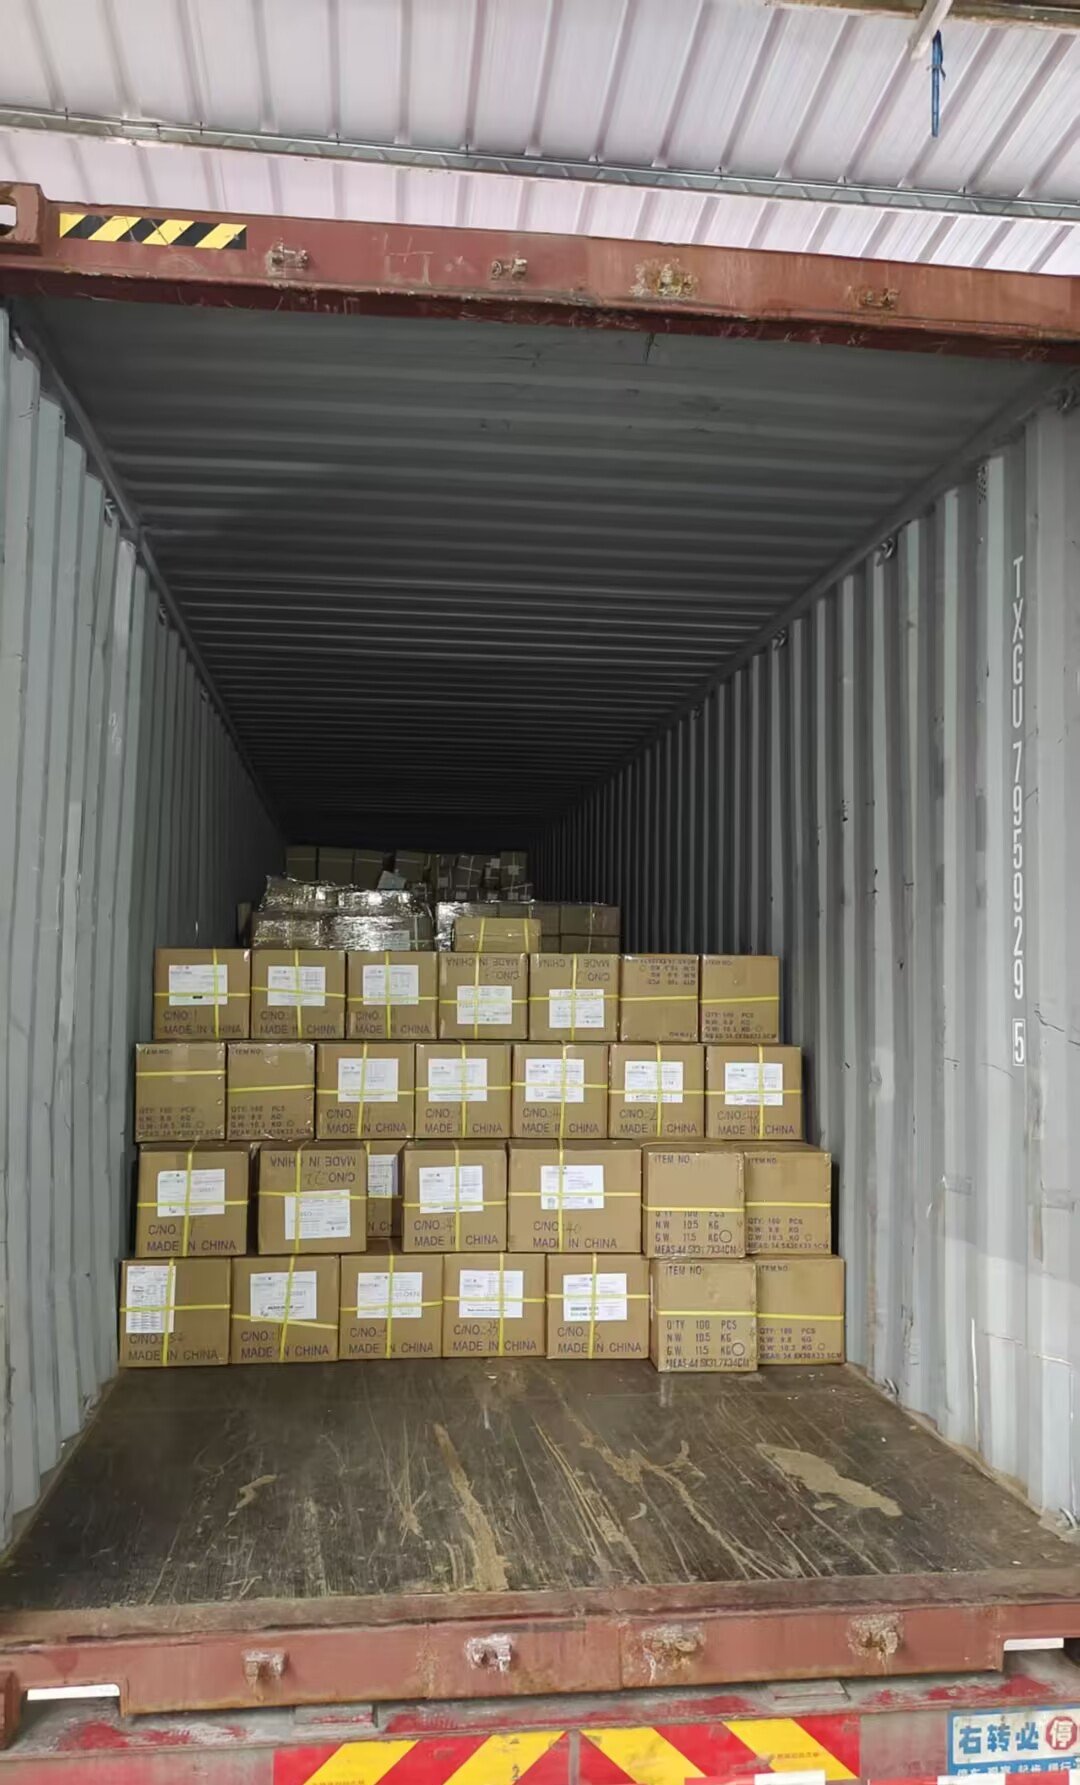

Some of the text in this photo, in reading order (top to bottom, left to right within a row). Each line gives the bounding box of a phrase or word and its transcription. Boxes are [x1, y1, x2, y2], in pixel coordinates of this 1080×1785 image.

[1012, 555, 1024, 1063] TXGU 795929 5
[583, 959, 610, 968] MADE
[164, 1025, 192, 1035] MADE
[260, 1024, 336, 1035] MADE CHINA
[355, 1024, 430, 1034] MADE CHINA
[326, 1123, 357, 1135] MADE
[375, 1122, 407, 1134] CHINA
[425, 1122, 453, 1134] MADE
[472, 1122, 503, 1134] CHINA
[522, 1123, 549, 1133] MADE
[568, 1122, 600, 1133] CHINA
[619, 1123, 648, 1134] MADE
[666, 1122, 697, 1133] CHINA
[718, 1125, 745, 1135] MADE
[764, 1124, 795, 1135] CHINA
[309, 1155, 320, 1167] IN
[325, 1155, 357, 1167] MADE
[654, 1154, 674, 1164] ITEM
[146, 1240, 180, 1252] MADE
[201, 1239, 237, 1251] CHINA
[414, 1235, 445, 1247] MADE
[465, 1234, 499, 1246] CHINA
[568, 1237, 580, 1249] IN
[584, 1237, 617, 1249] CHINA
[665, 1265, 686, 1275] ITEM
[695, 1319, 710, 1330] 100
[720, 1319, 737, 1330] PCS
[720, 1333, 732, 1342] KG
[241, 1346, 273, 1358] MADE
[294, 1344, 329, 1356] CHINA
[348, 1343, 380, 1354] MADE
[400, 1342, 434, 1353] CHINA
[452, 1340, 537, 1352] MADE IN CHINA
[557, 1342, 589, 1353] MADE
[608, 1342, 642, 1353] CHINA
[720, 1346, 731, 1355] KG
[128, 1350, 160, 1361] MADE
[183, 1349, 219, 1360] CHINA
